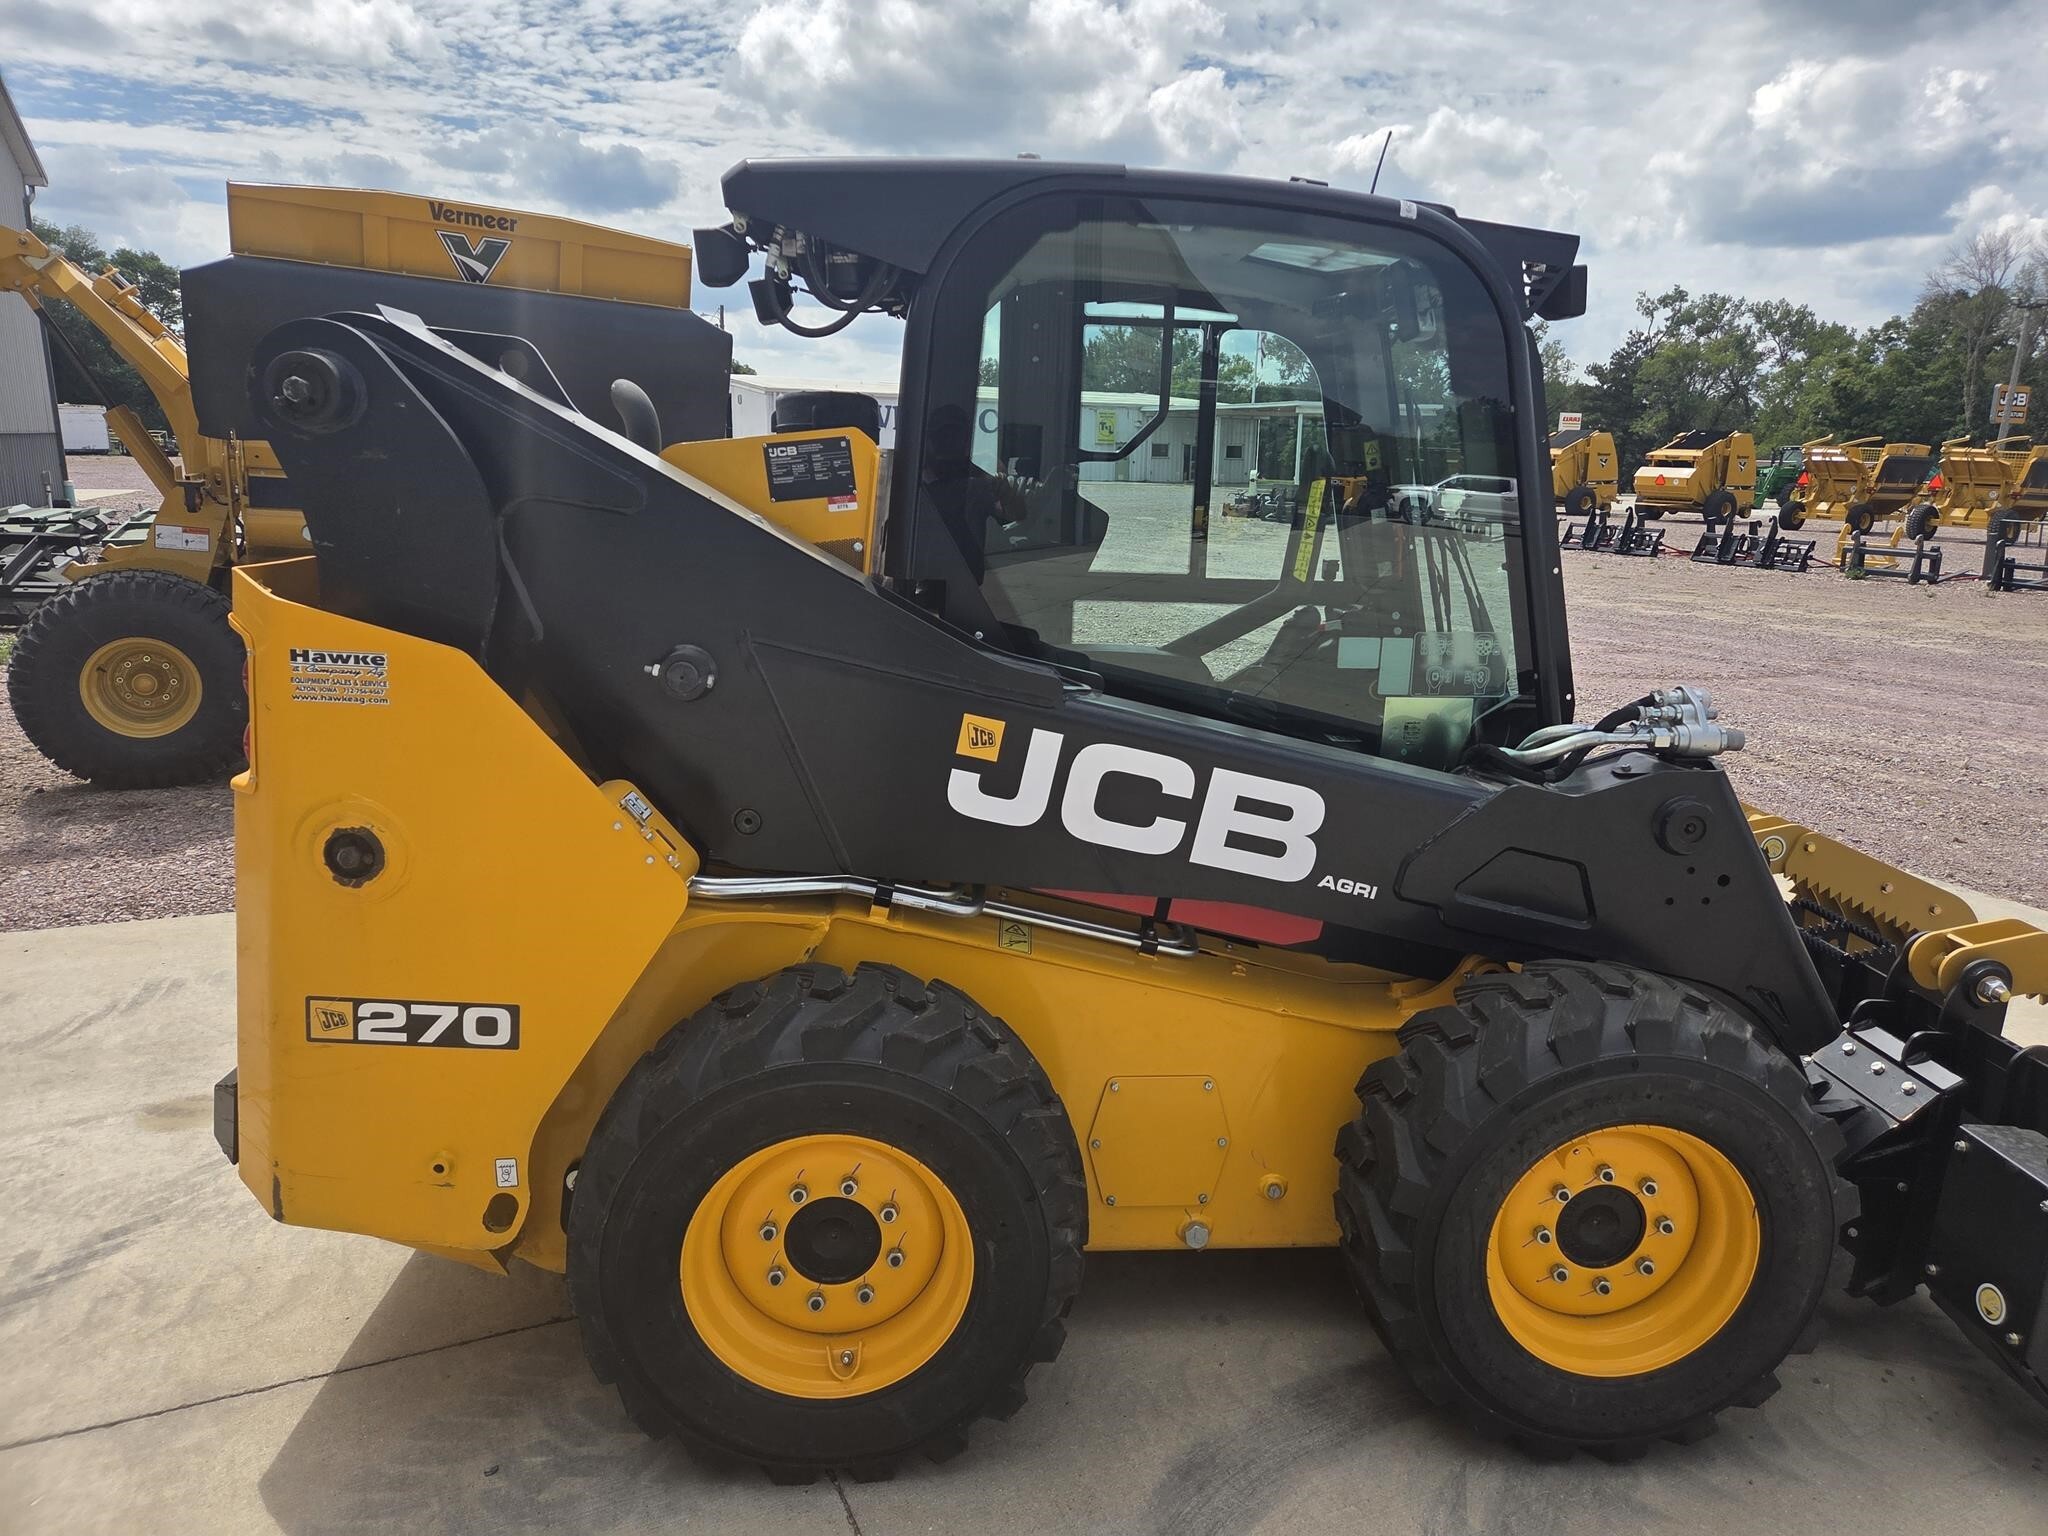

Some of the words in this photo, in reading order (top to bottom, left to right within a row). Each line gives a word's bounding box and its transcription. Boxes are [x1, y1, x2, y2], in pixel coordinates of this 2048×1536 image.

[429, 201, 517, 232] Vermeer
[768, 446, 798, 458] JCB
[290, 649, 385, 666] Hawke
[305, 664, 361, 677] Company
[291, 677, 329, 685] EQUIPMENT
[292, 694, 388, 704] www.hawkeag.com
[971, 726, 994, 746] JCB
[948, 728, 1326, 883] JCB
[1317, 875, 1378, 900] AGRI
[321, 1011, 347, 1029] JCB
[357, 1002, 511, 1046] 270
